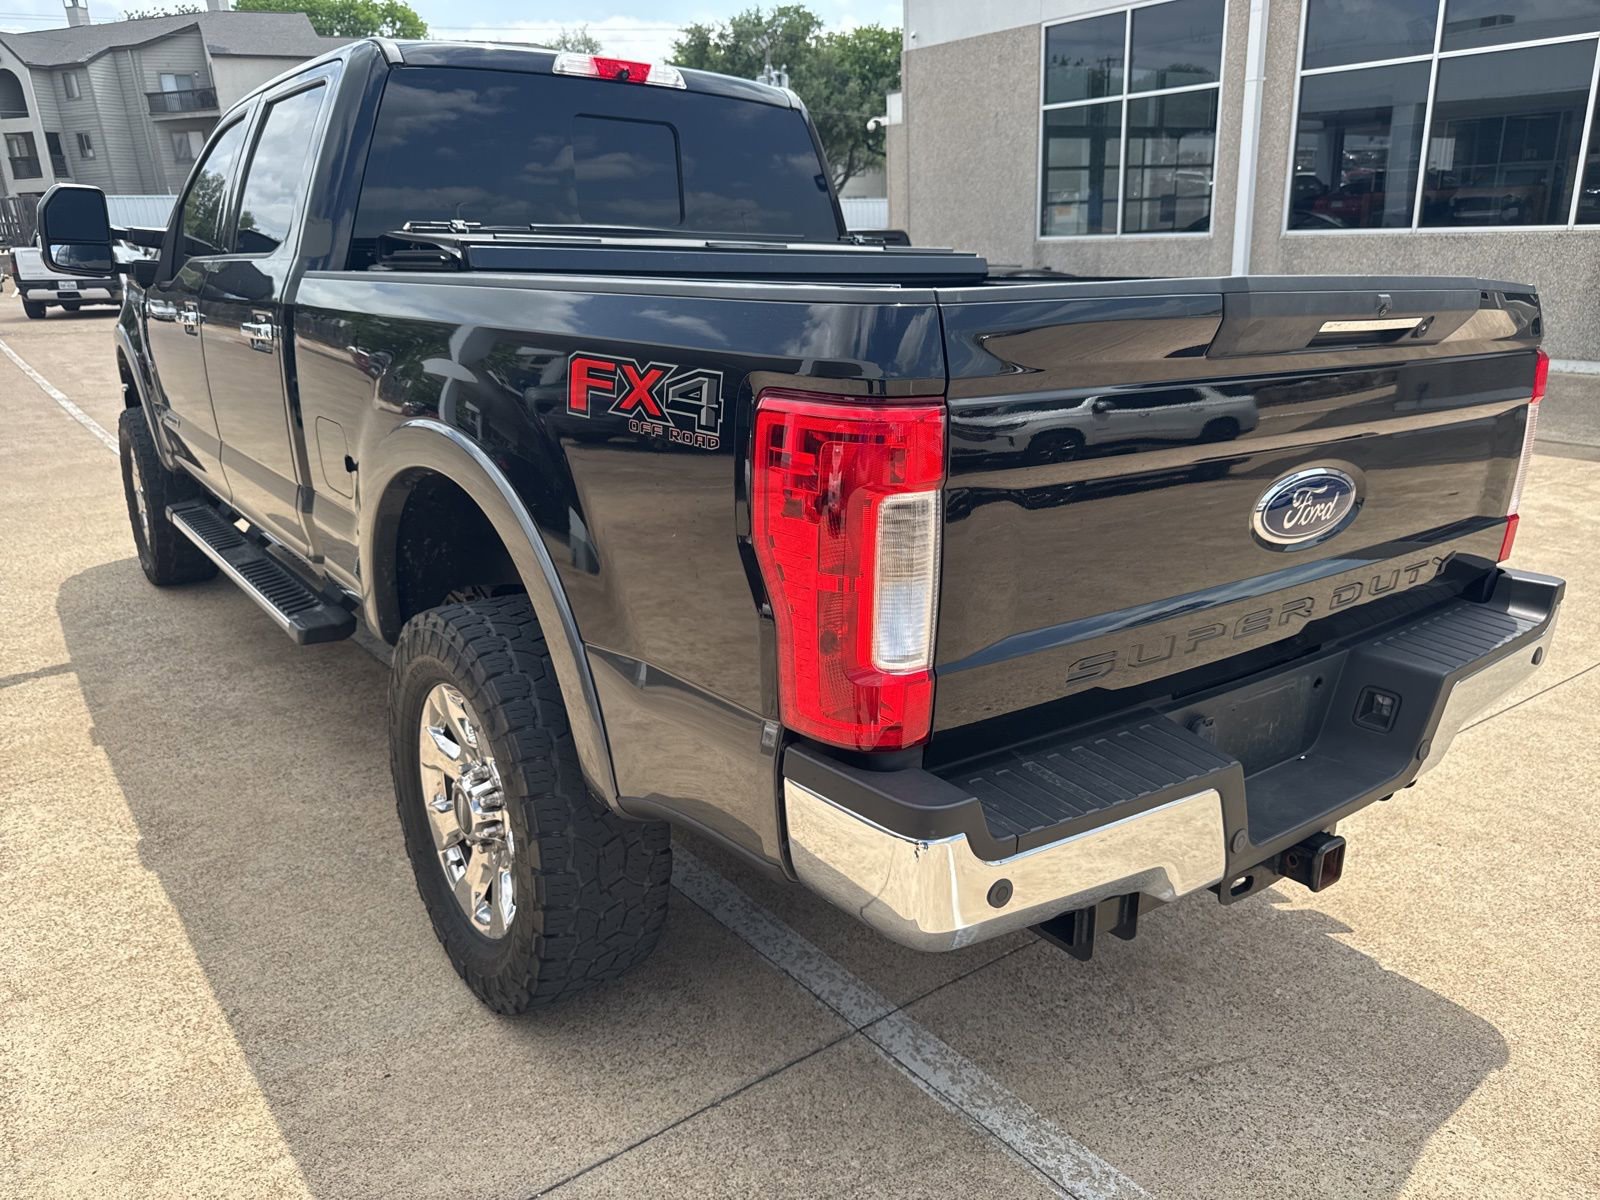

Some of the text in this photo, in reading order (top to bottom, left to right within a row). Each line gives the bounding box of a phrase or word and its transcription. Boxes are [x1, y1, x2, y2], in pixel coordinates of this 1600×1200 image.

[567, 351, 724, 436] FX4
[629, 419, 720, 450] OFF ROAD
[1283, 485, 1340, 529] Ford
[1066, 550, 1457, 687] SUPER DUTY
